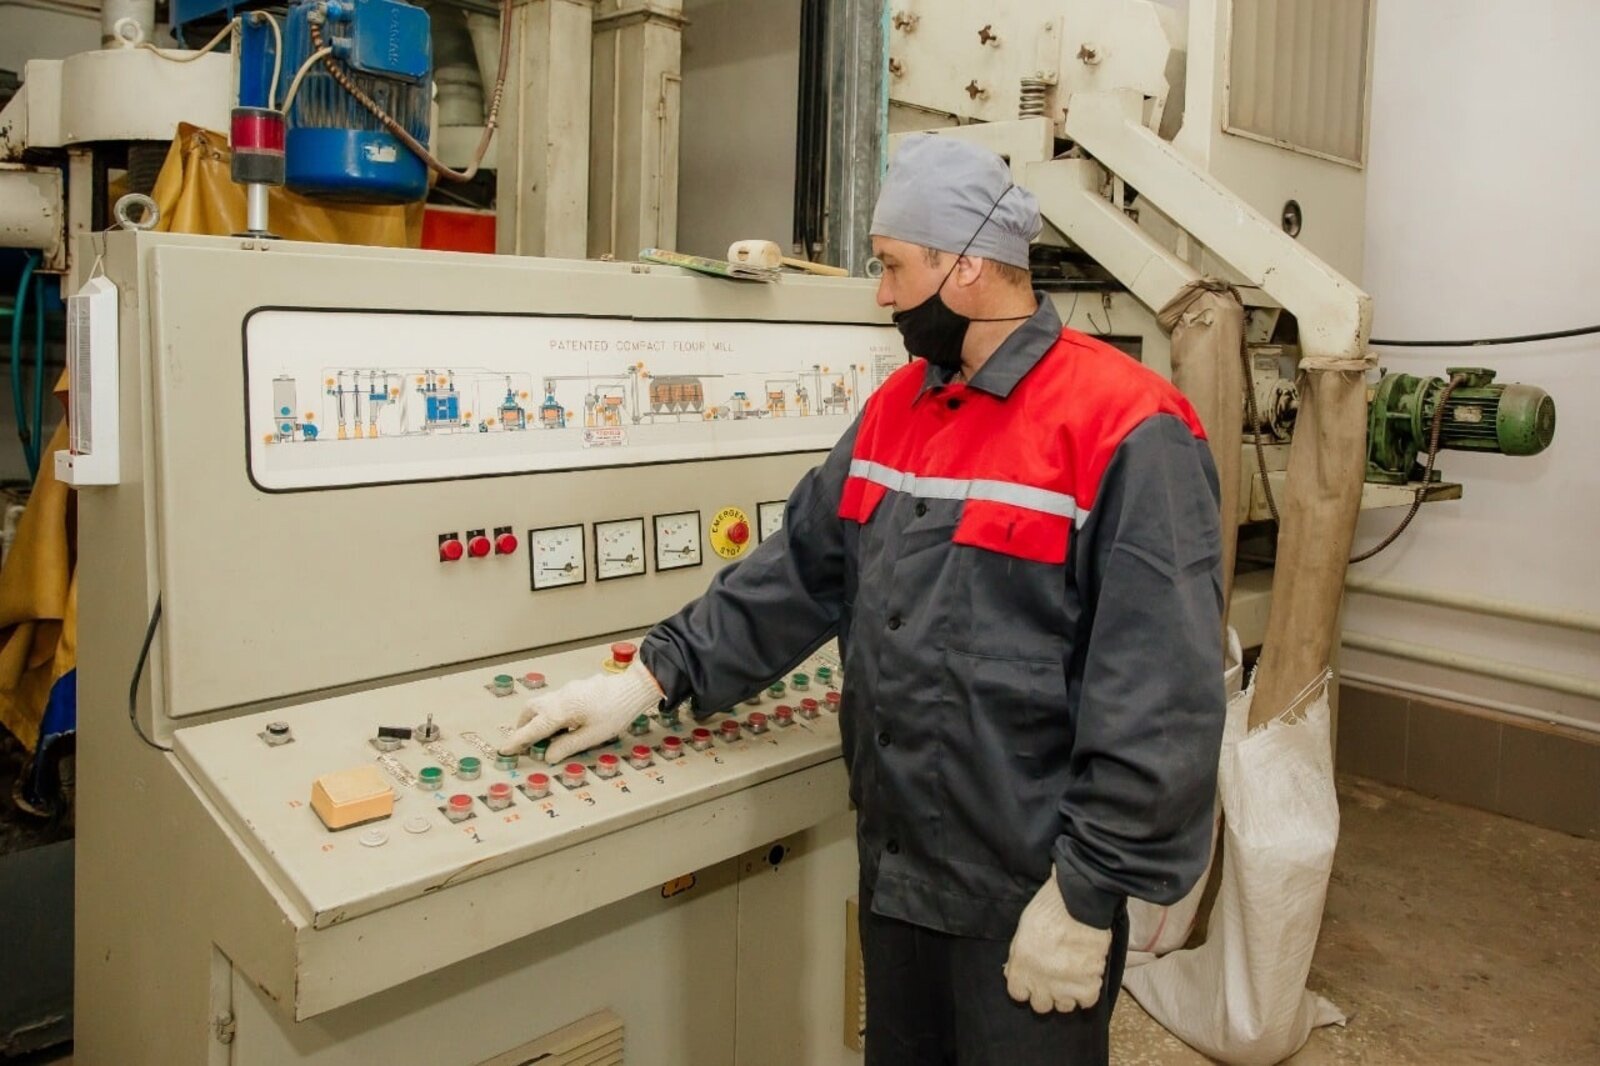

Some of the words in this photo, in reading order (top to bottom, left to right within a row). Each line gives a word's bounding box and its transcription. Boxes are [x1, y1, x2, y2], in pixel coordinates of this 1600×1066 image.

[549, 339, 609, 351] PATENTED
[615, 339, 666, 352] COMPACT
[672, 341, 705, 352] FLOUR
[711, 341, 735, 352] MILL
[712, 509, 748, 534] EMERGEN
